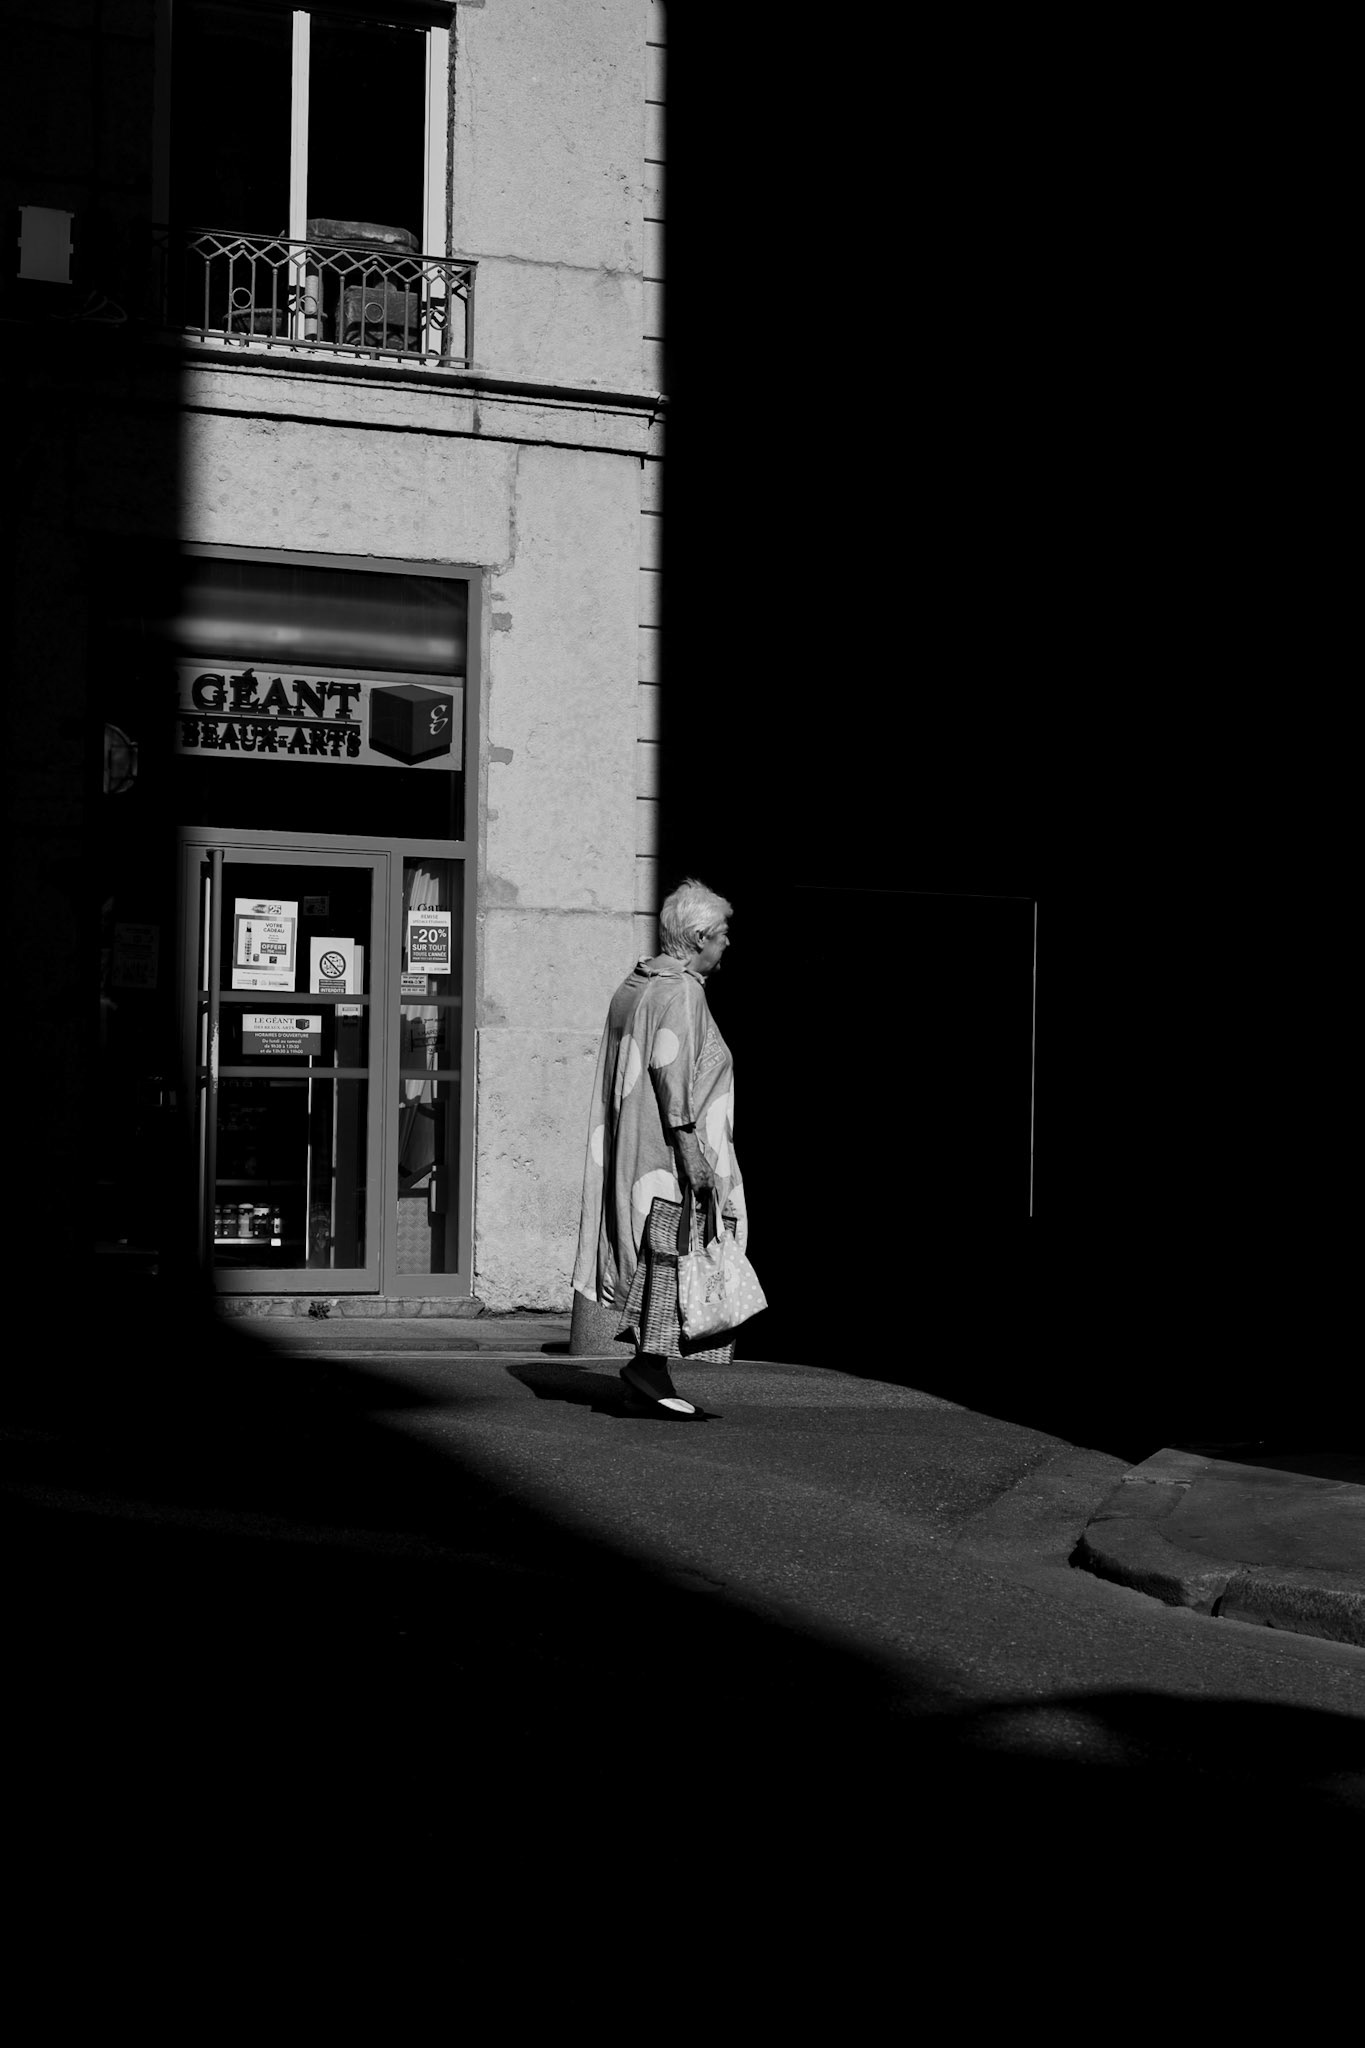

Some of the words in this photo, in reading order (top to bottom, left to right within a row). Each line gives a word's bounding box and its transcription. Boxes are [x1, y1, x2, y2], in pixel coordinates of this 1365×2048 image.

[192, 668, 362, 720] GÉANT
[181, 720, 362, 757] BEAUX-ARTS
[262, 943, 286, 951] OFFERT
[412, 928, 447, 943] -20%
